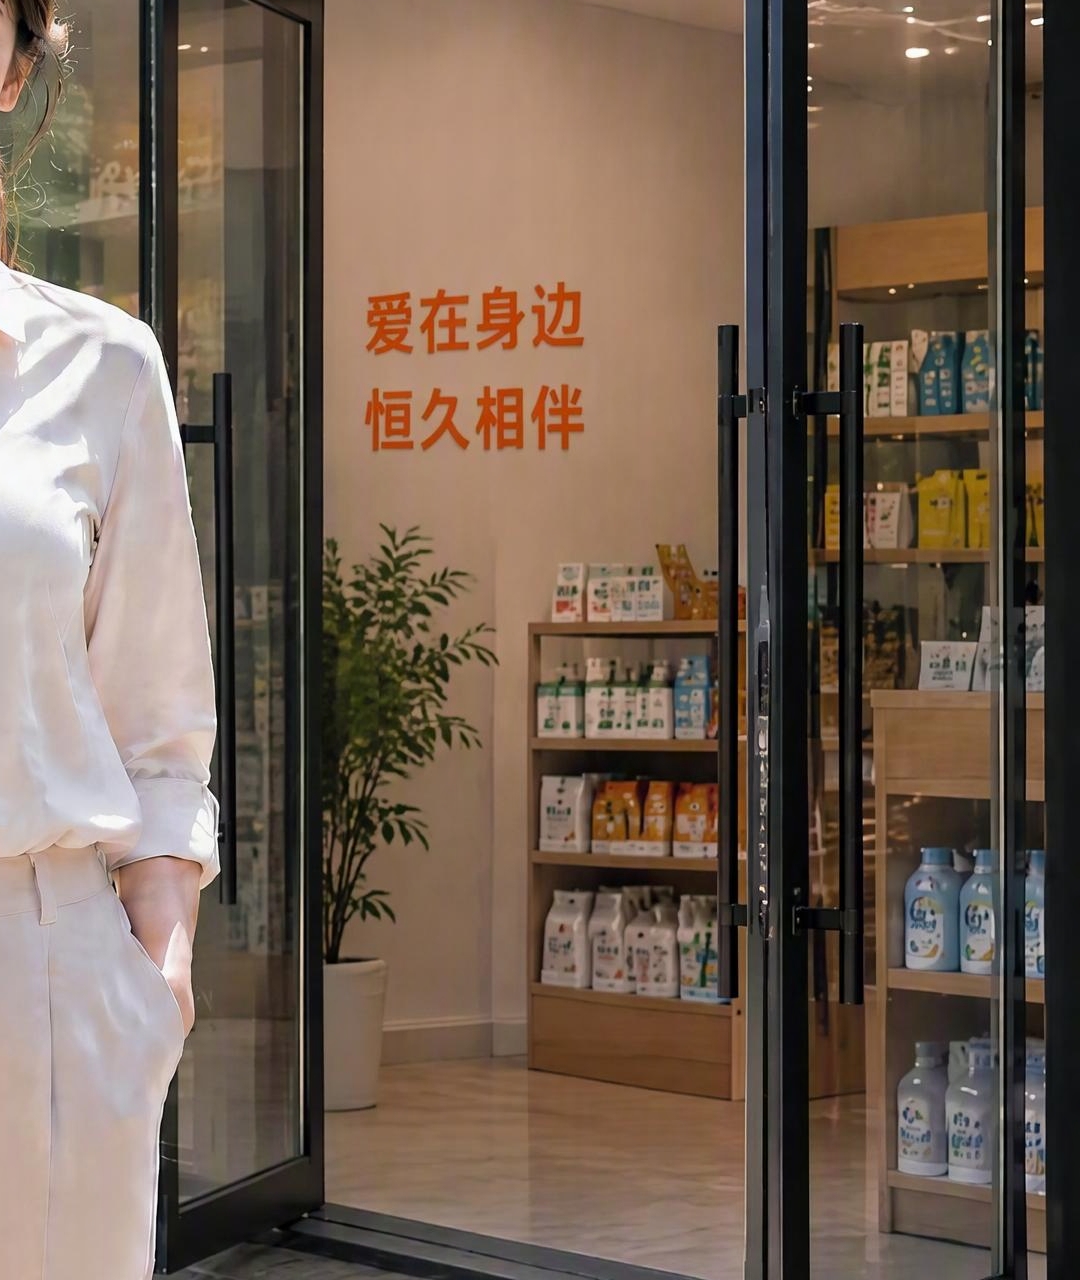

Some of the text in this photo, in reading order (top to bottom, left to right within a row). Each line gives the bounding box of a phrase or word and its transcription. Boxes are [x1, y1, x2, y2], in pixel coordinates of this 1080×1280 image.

[365, 281, 585, 356] 爱在身边
[364, 384, 585, 452] 恒久相伴
